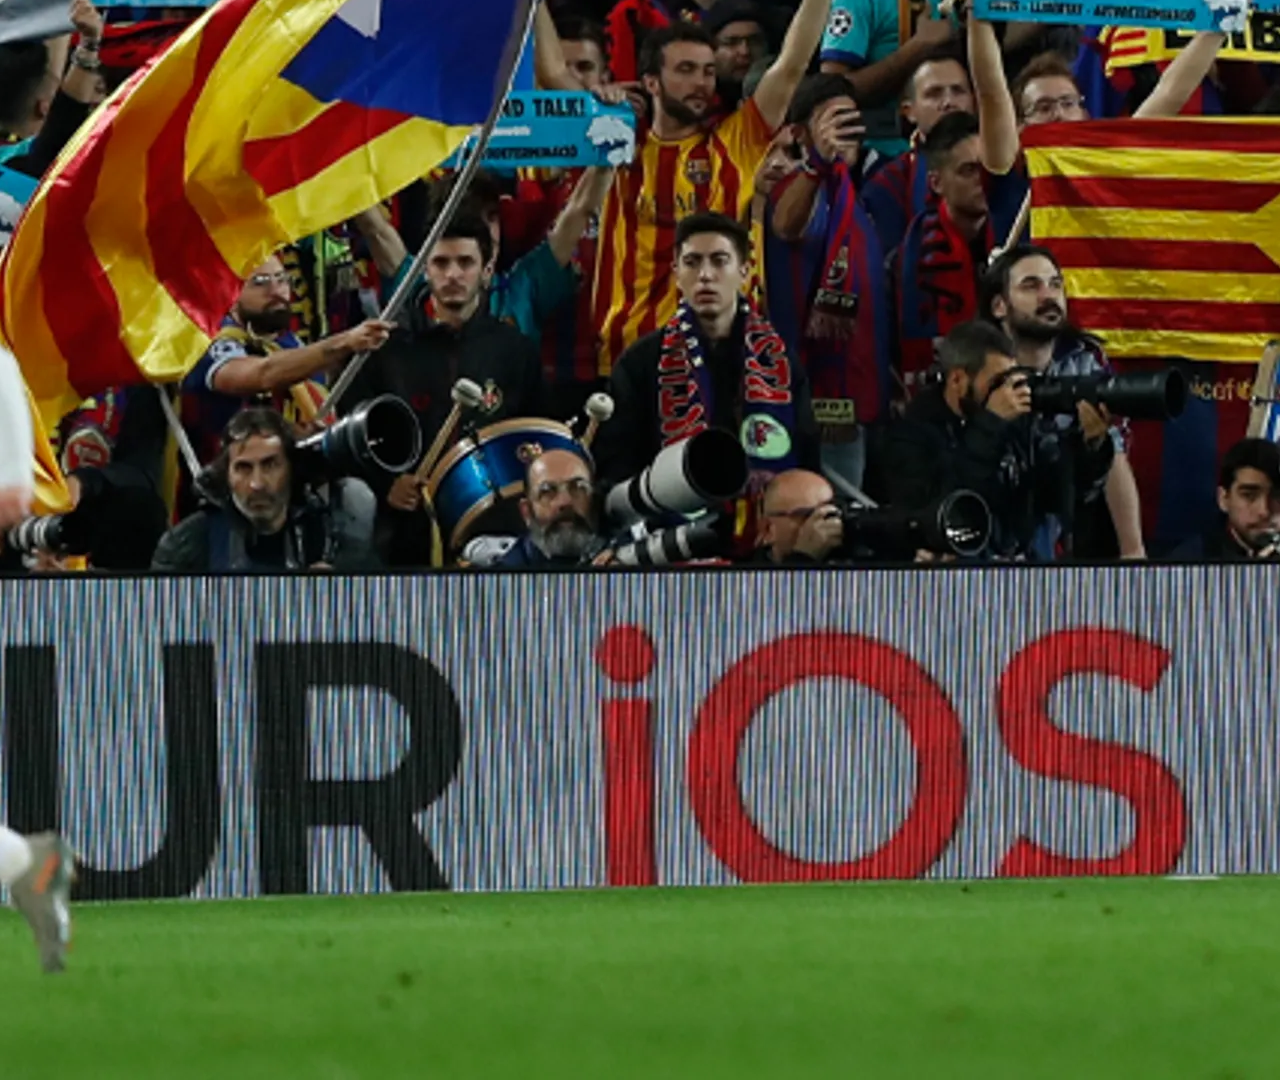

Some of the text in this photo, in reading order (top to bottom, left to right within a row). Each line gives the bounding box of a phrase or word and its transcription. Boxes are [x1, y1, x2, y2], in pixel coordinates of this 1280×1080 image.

[503, 97, 586, 118] ND TALK!
[595, 623, 1188, 886] iOS
